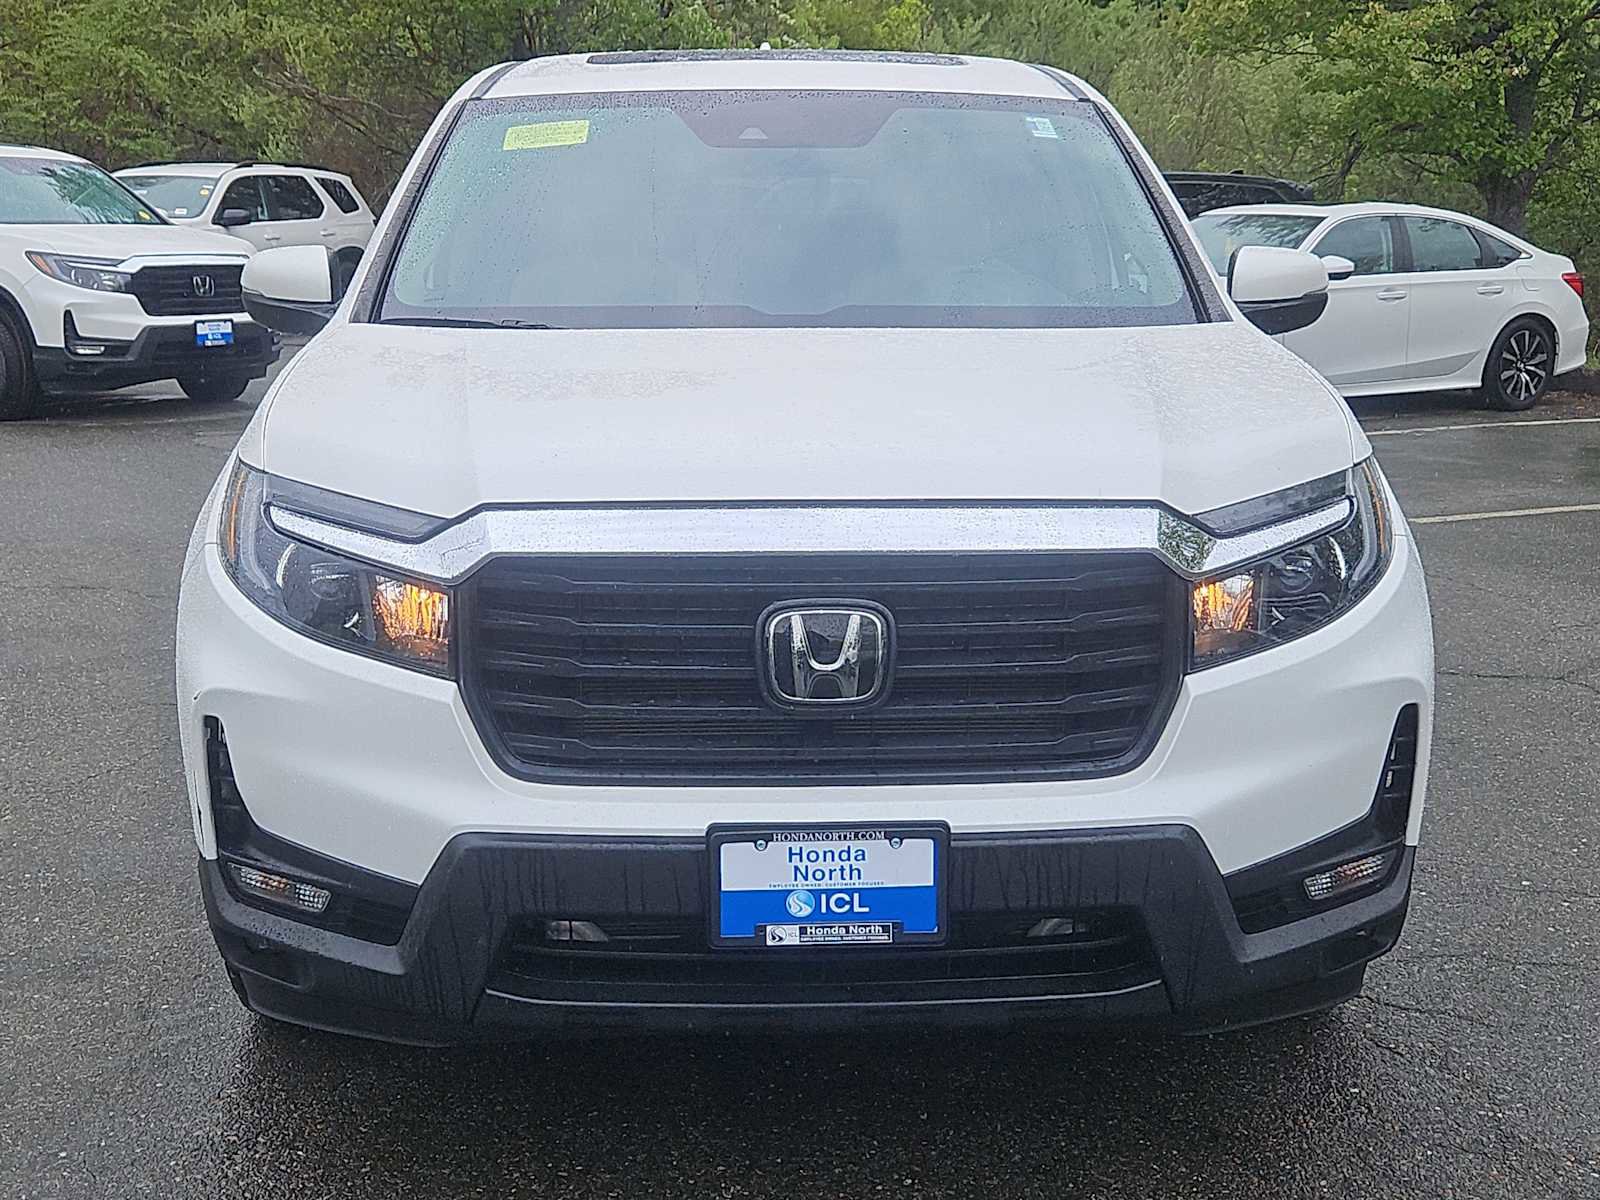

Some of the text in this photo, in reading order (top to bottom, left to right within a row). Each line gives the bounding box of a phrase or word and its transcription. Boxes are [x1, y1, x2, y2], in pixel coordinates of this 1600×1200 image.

[772, 831, 885, 841] HONDANORTH.COM
[788, 845, 866, 863] Honda
[793, 864, 862, 882] North
[820, 892, 870, 914] ICL
[806, 924, 883, 936] Honda North
